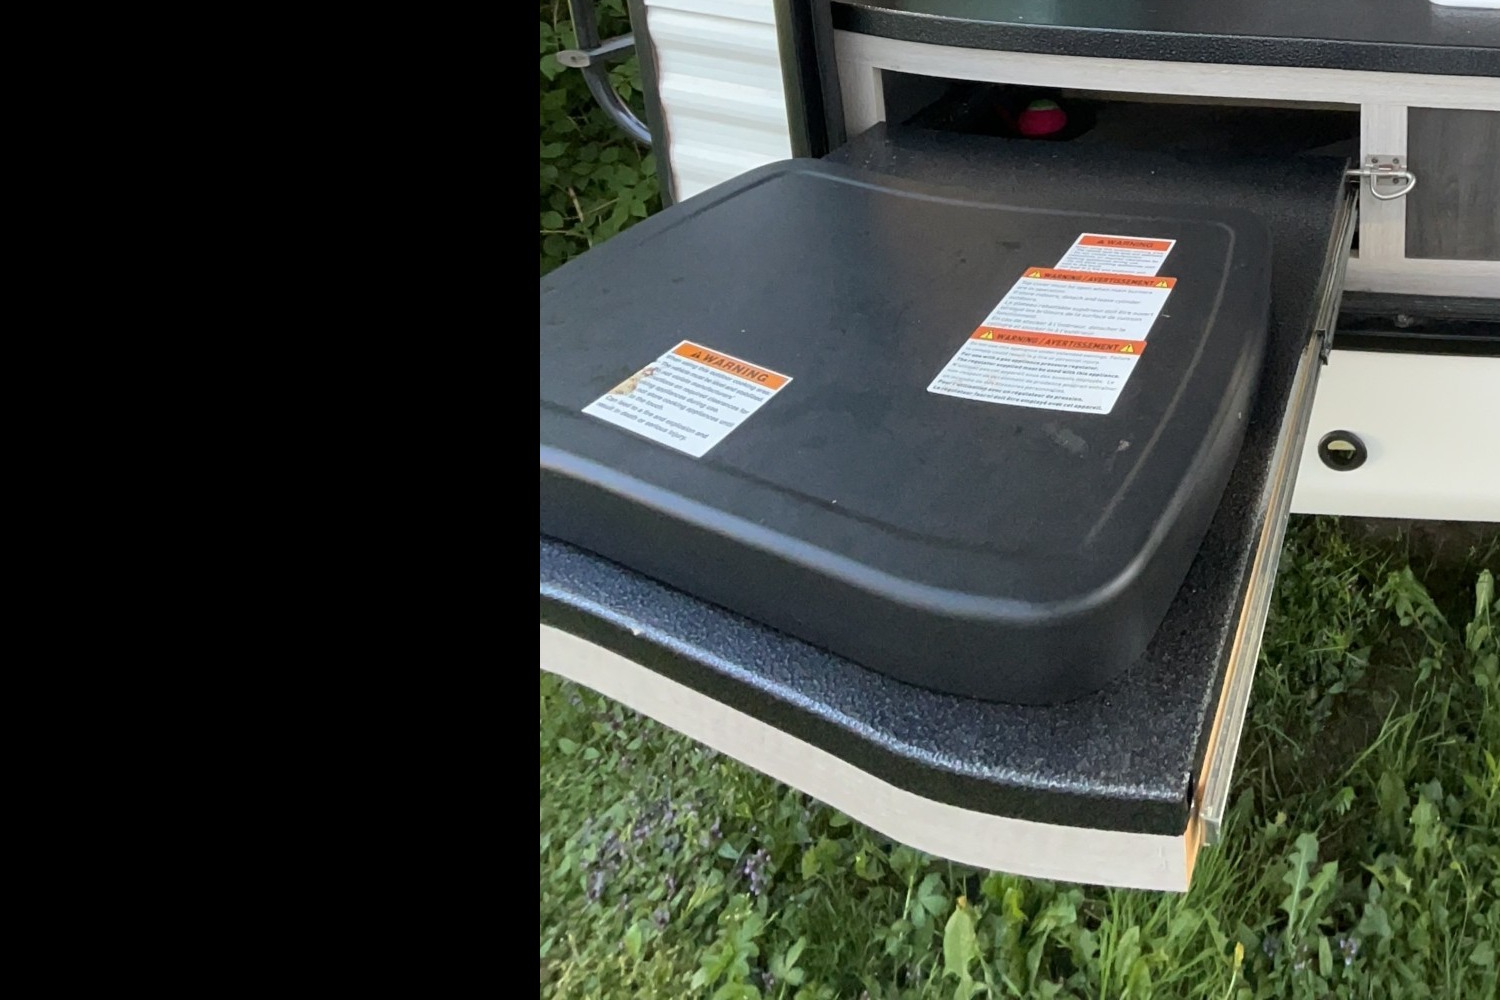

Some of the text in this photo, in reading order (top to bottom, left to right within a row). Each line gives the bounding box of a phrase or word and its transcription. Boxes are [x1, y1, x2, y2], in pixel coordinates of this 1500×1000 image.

[1042, 272, 1083, 280] WARNING
[1087, 276, 1154, 285] AVERTISSEMENT
[994, 334, 1039, 342] WARNING
[1043, 338, 1119, 350] AVERTISSEMENT
[700, 353, 770, 382] WARNING
